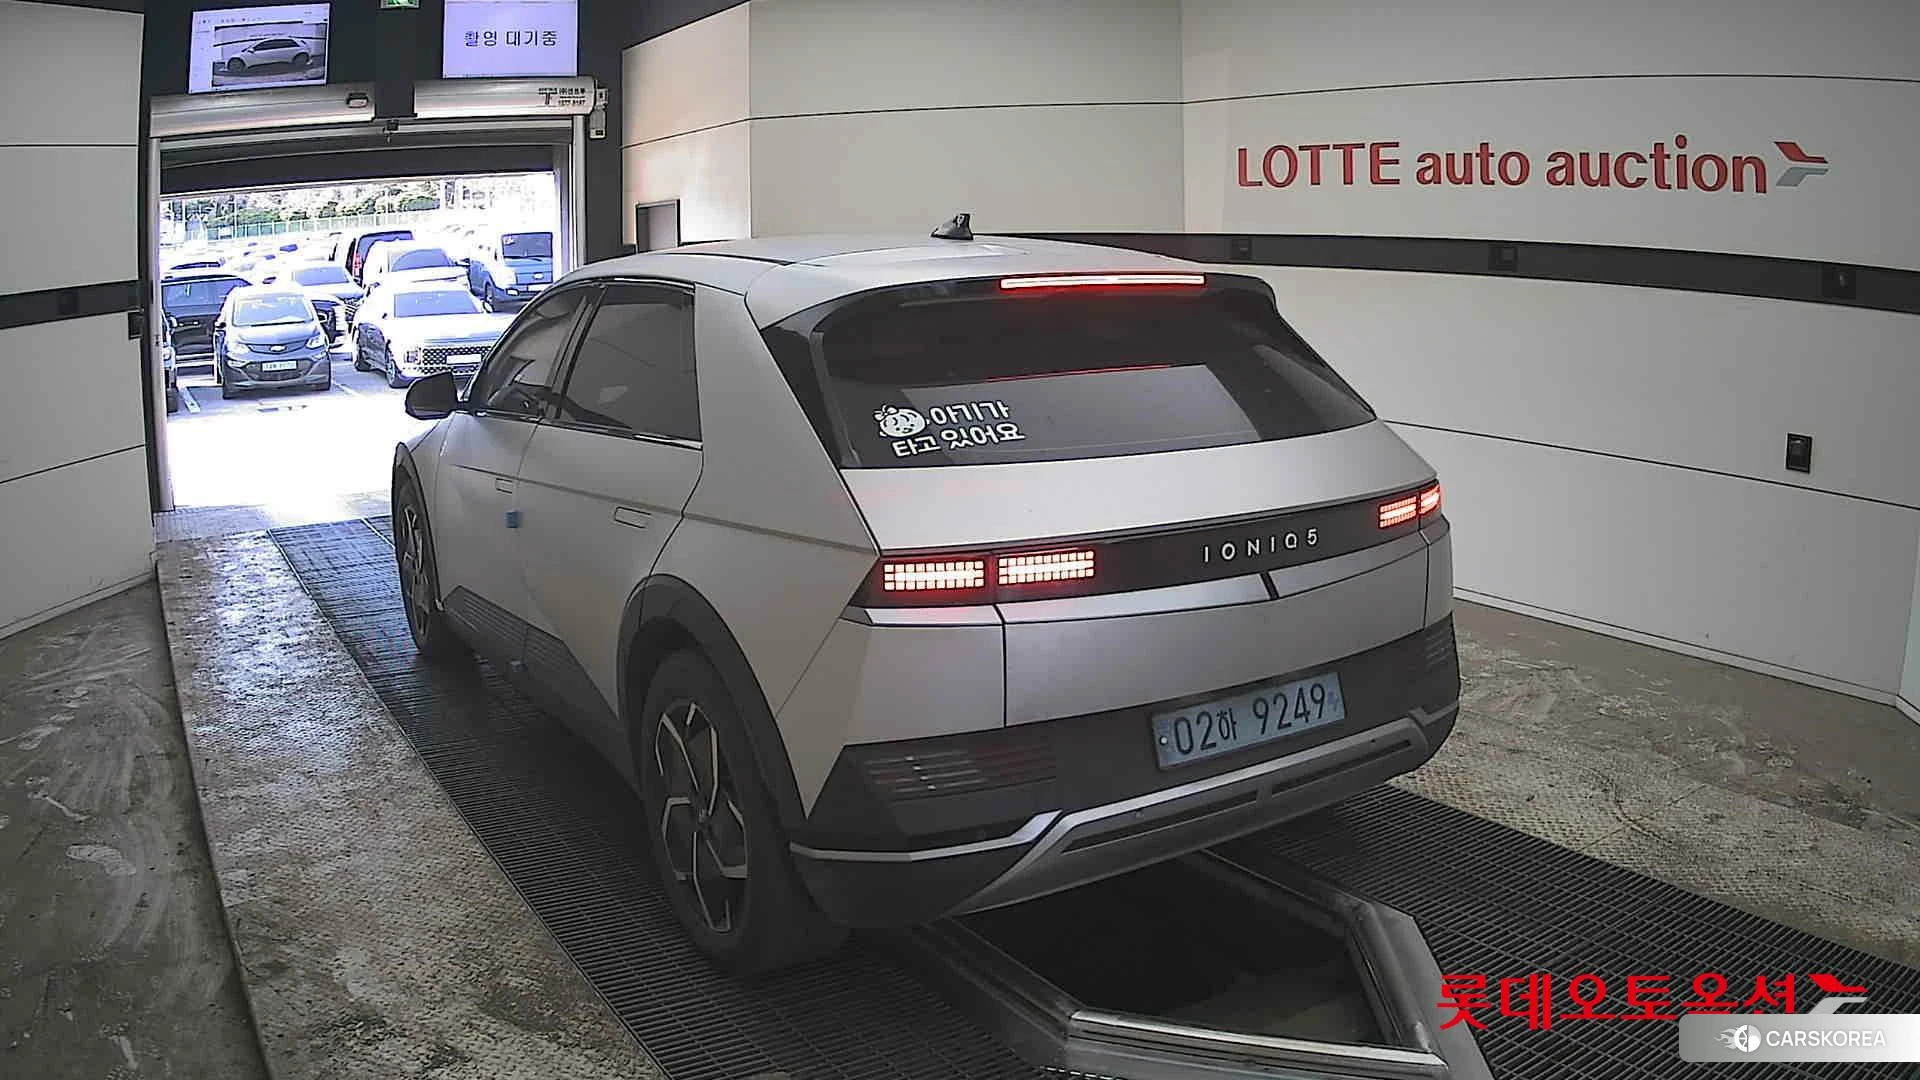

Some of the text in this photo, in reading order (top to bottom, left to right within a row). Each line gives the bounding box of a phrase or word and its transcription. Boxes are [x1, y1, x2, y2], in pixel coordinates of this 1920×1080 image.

[505, 30, 558, 47] 대기중
[1238, 134, 1768, 194] LOTTE auto auction
[929, 401, 1009, 425] 아기가
[892, 422, 1026, 457] 타고 있어요
[1173, 682, 1326, 755] 02하 9249
